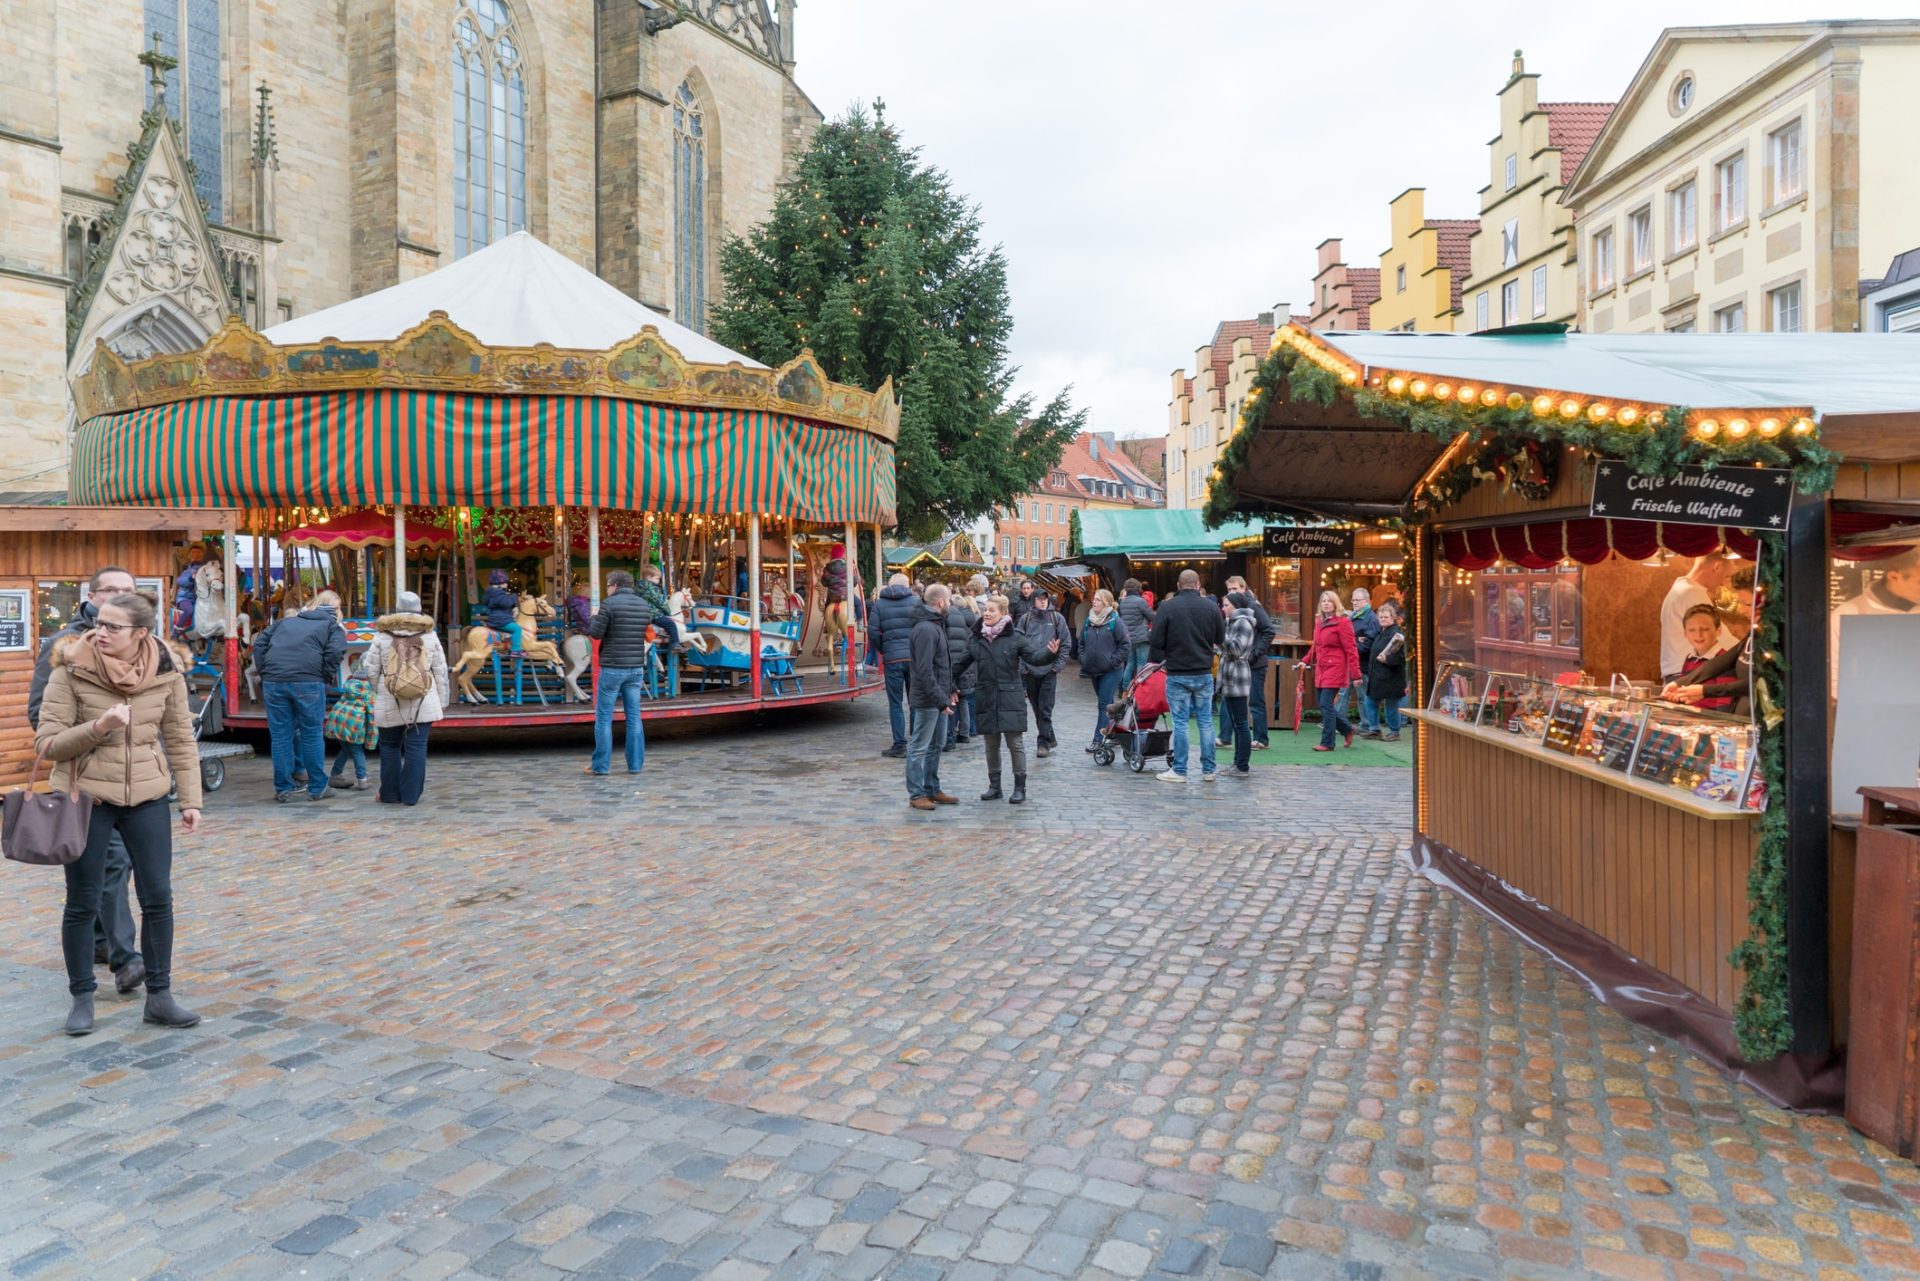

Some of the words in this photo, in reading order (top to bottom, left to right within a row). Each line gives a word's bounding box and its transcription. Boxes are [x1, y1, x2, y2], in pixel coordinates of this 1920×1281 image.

[1626, 473, 1665, 491] Café
[1670, 471, 1755, 497] Ambiente
[1631, 498, 1682, 514] Frische
[1686, 501, 1743, 519] Waffeln
[1272, 531, 1295, 544] Café
[1297, 530, 1344, 545] Ambiente
[1290, 542, 1326, 556] Crêpes
